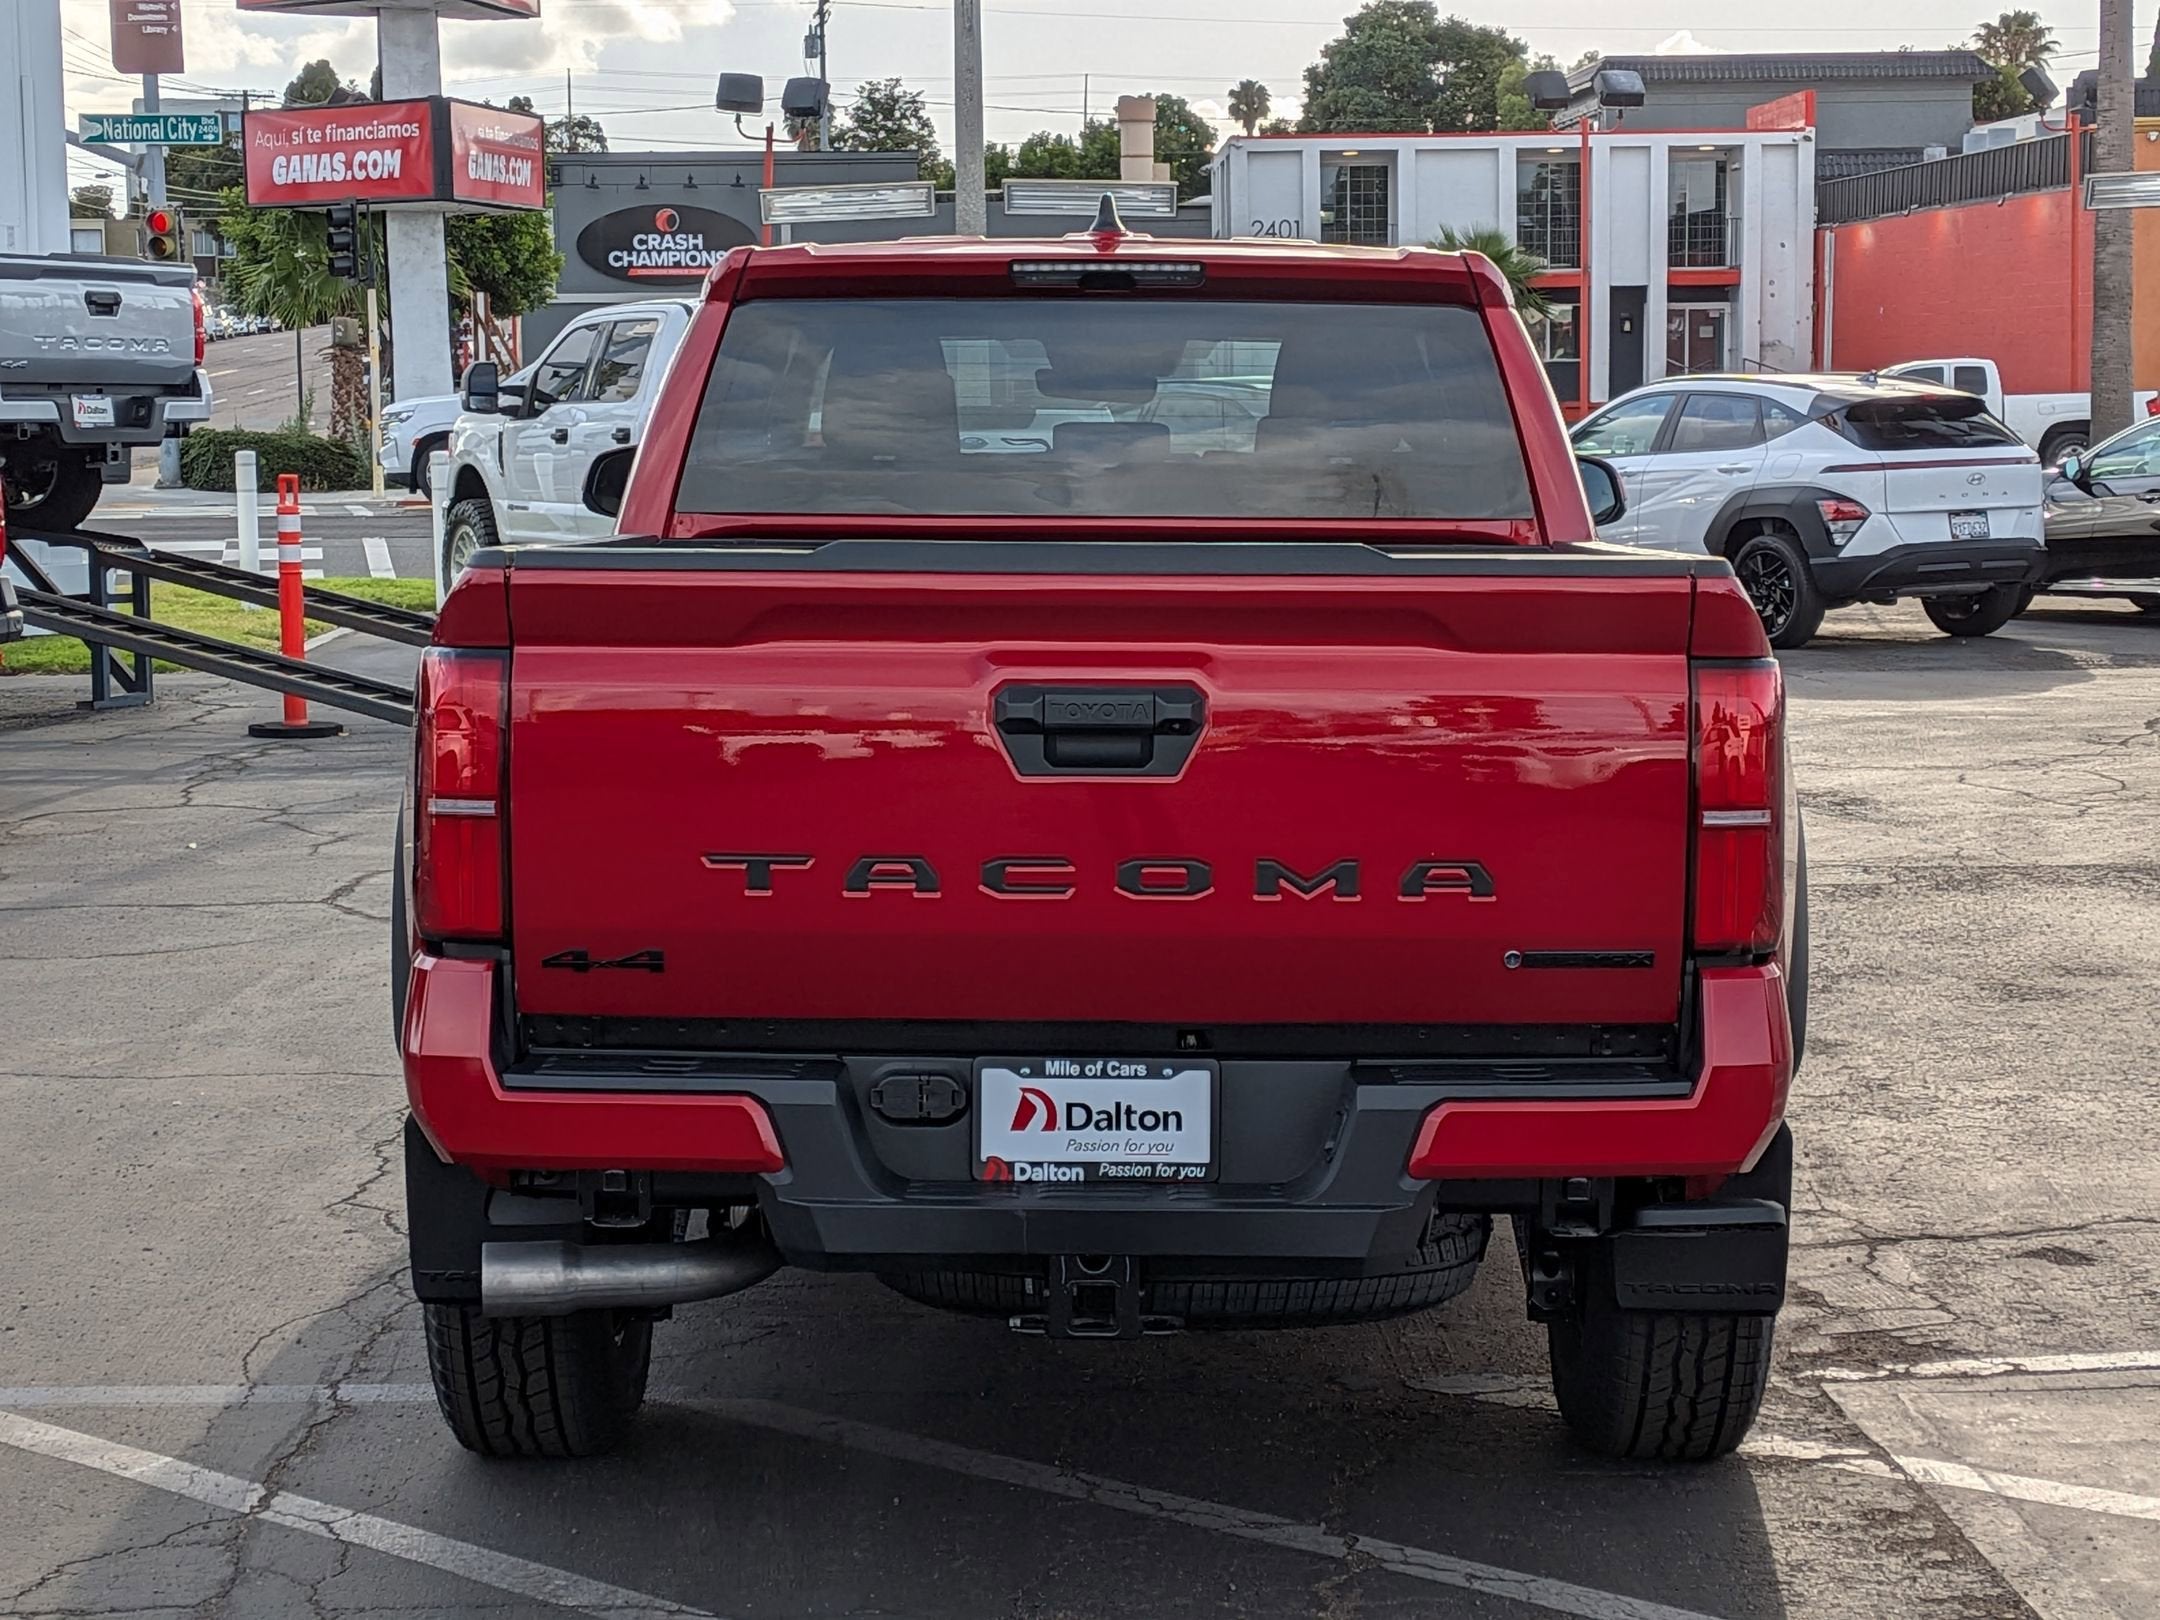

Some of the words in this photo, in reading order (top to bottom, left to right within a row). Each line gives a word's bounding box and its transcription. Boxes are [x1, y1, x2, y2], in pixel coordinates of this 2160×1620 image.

[103, 118, 164, 140] National
[167, 116, 197, 141] City
[307, 127, 322, 144] te
[325, 120, 420, 143] financiamos
[272, 149, 402, 186] GANAS.COM
[468, 150, 531, 187] GANAS.COM
[1251, 219, 1300, 239] 2401
[632, 233, 703, 250] CRASH
[33, 335, 170, 353] TACOMA
[1050, 702, 1149, 720] TOYOTA
[700, 853, 1498, 903] TACOMA
[1045, 1061, 1080, 1077] Mile
[1085, 1060, 1103, 1077] of
[1106, 1061, 1148, 1078] Cars
[1065, 1101, 1183, 1132] Dalton
[1065, 1138, 1119, 1152] Passion
[1122, 1138, 1145, 1153] for
[1147, 1142, 1175, 1156] you
[1014, 1163, 1085, 1182] Dalton
[1098, 1162, 1151, 1178] Passion
[1154, 1161, 1176, 1178] for
[1177, 1166, 1206, 1179] you
[1623, 1283, 1779, 1295] TACOMA
